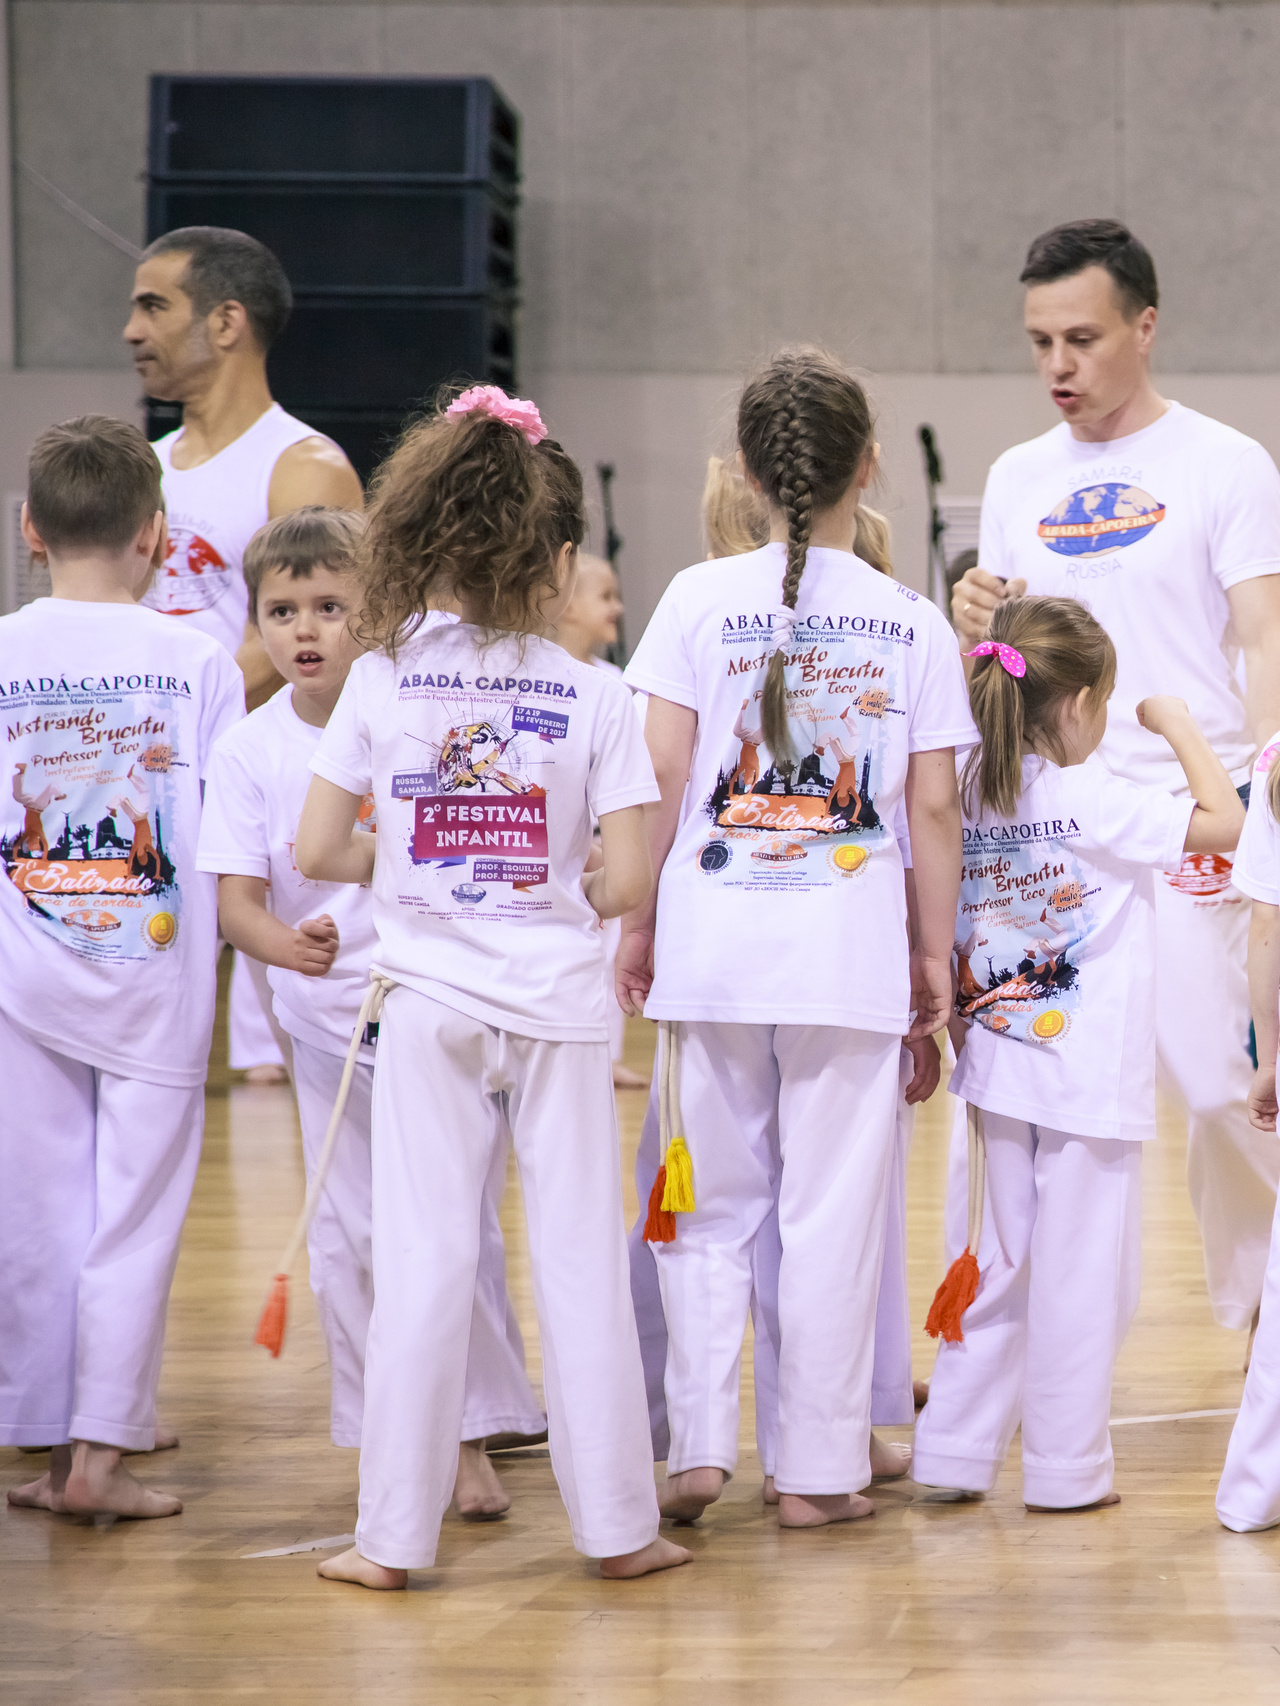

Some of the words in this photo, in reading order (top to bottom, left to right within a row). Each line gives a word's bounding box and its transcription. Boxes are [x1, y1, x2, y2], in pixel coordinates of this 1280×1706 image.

[721, 613, 915, 641] ABA-CAPOEIRA
[721, 636, 757, 644] Presidente
[727, 645, 829, 677] Mestando
[799, 660, 884, 682] Brucutu
[828, 681, 857, 695] Teco
[398, 693, 431, 702] Presidente
[470, 696, 493, 704] Mestre
[494, 697, 520, 705] Camisa
[514, 714, 524, 722] DE
[526, 716, 567, 730] FEVEREIRO
[532, 709, 540, 717] 19
[77, 716, 165, 745] Brucutu
[537, 726, 547, 734] DE
[549, 728, 565, 736] 2017
[31, 750, 102, 767] Professor
[111, 742, 140, 755] Teco
[395, 776, 424, 785] RÚSSIA
[398, 786, 433, 794] SAMARA
[446, 805, 545, 824] FESTIVAL
[727, 796, 850, 831] Batizado
[436, 830, 533, 848] INFANTIL
[962, 818, 1080, 842] DÁ-CAPOEIRA
[475, 863, 500, 871] PROF.
[502, 863, 545, 873] ESQUILÃO
[475, 872, 500, 880] PROF.
[502, 873, 540, 881] BRONCO
[993, 862, 1064, 892] Brucutu
[24, 862, 155, 893] Batizado
[68, 896, 87, 907] de
[93, 898, 144, 908] cordas
[961, 896, 1013, 915] Professor
[1019, 888, 1045, 902] Teco
